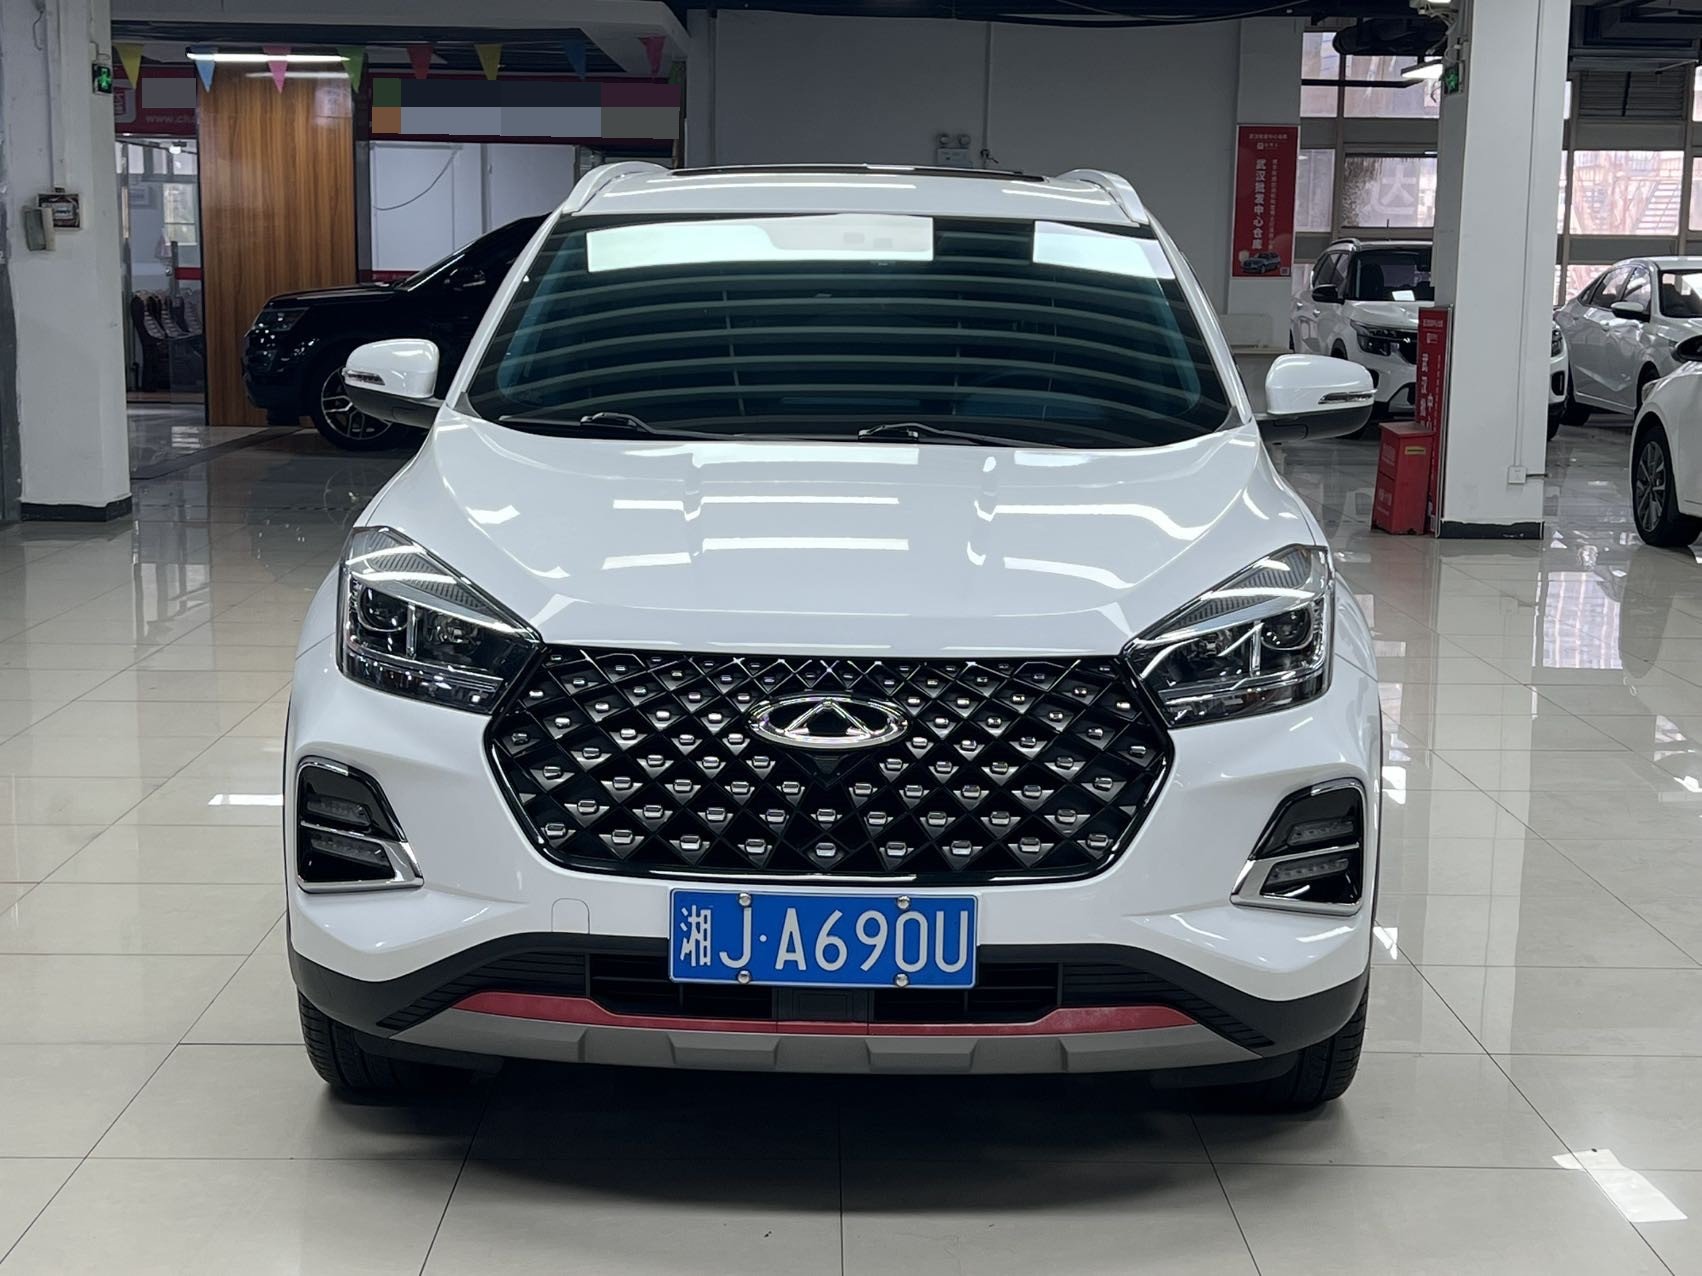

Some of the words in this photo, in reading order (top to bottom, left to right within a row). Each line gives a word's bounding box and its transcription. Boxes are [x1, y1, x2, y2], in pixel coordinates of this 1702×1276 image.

[1252, 158, 1267, 250] 武汉批发中心仓库
[680, 904, 969, 973] 湘J·A690U
